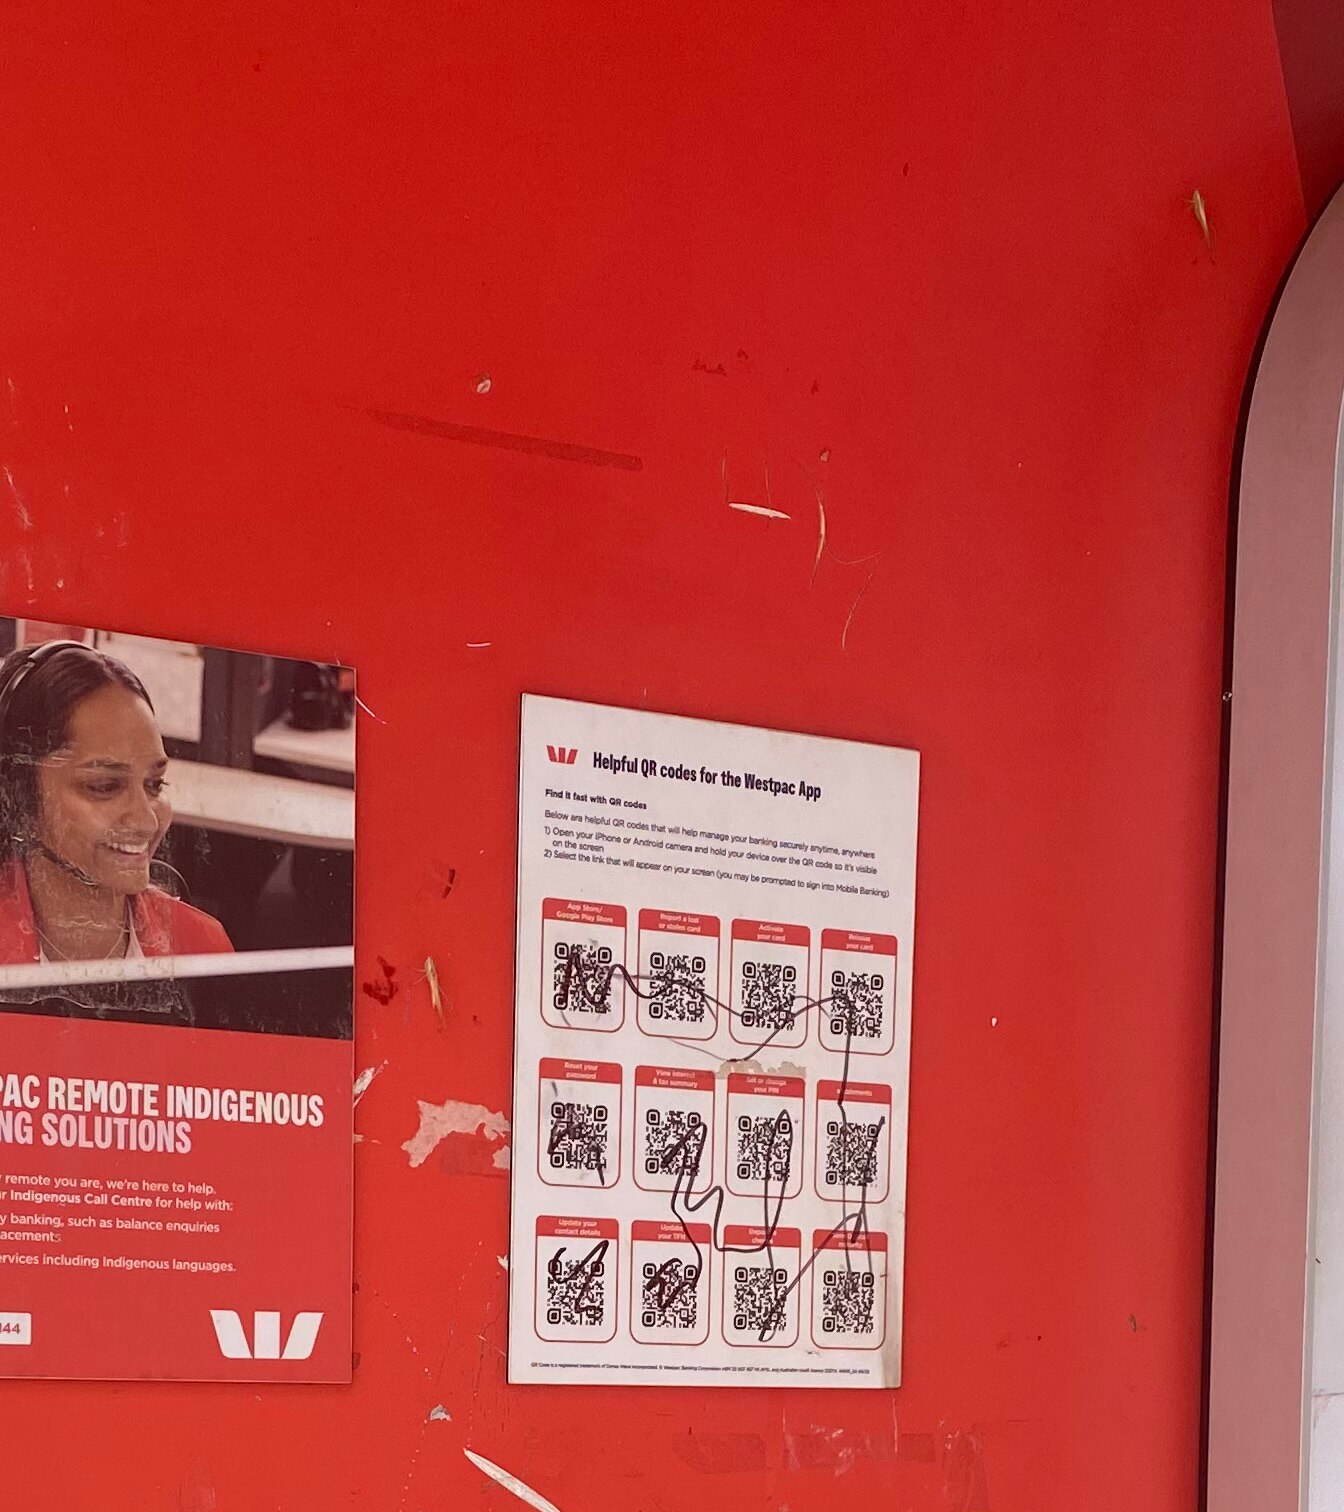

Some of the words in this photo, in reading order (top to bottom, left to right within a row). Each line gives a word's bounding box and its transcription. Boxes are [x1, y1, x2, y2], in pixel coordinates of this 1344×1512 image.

[593, 751, 637, 774] Helpful
[640, 758, 656, 778] QR
[660, 763, 696, 781] codes
[699, 766, 717, 784] for
[720, 770, 741, 787] the
[744, 772, 795, 796] Westpac
[798, 780, 821, 802] App
[545, 788, 563, 798] Find
[565, 790, 571, 799] it
[572, 791, 587, 802] fast
[589, 795, 607, 804] with
[608, 797, 621, 806] QR
[623, 800, 647, 809] codes
[564, 840, 577, 849] the
[578, 843, 604, 852] screen
[48, 1076, 160, 1117] REMOTE
[167, 1085, 324, 1127] INDIGENOUS
[42, 1113, 192, 1154] SOLUTIONS
[5, 1174, 50, 1185] remote
[53, 1177, 76, 1188] you
[80, 1178, 103, 1190] are,
[106, 1178, 138, 1190] we're
[142, 1179, 169, 1191] here
[171, 1181, 184, 1192] to
[186, 1182, 216, 1196] help.
[10, 1189, 80, 1203] Indigenous
[83, 1192, 107, 1204] Call
[110, 1194, 152, 1207] Centre
[155, 1196, 172, 1207] for
[174, 1197, 201, 1211] help
[204, 1199, 232, 1211] with:
[8, 1212, 64, 1227] banking,
[67, 1215, 95, 1227] such
[98, 1219, 113, 1229] as
[115, 1217, 163, 1230] balance
[165, 1221, 219, 1233] enquiries
